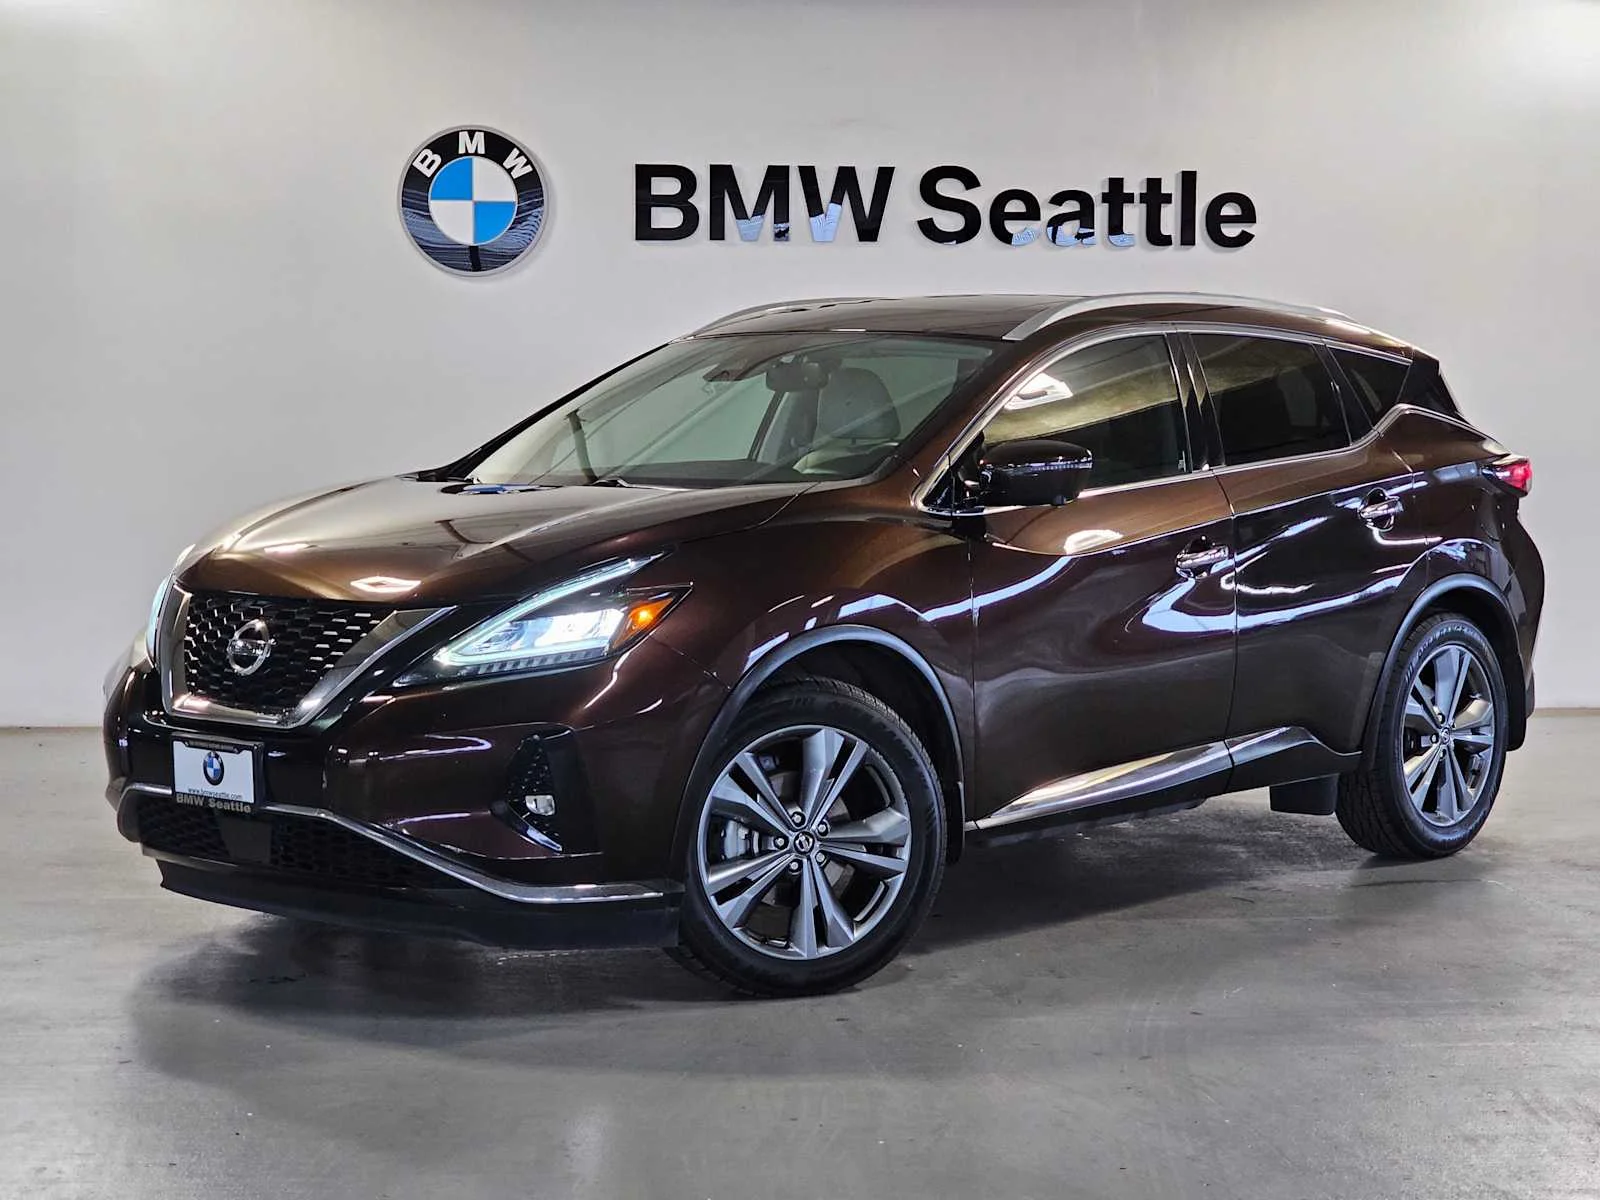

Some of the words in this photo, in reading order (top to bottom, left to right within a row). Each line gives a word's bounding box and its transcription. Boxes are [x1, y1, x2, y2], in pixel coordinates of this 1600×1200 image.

[412, 131, 533, 179] BMW
[635, 164, 896, 242] BMW
[917, 165, 1257, 248] Seattle
[176, 793, 204, 806] BMW
[208, 797, 251, 813] Seattle
